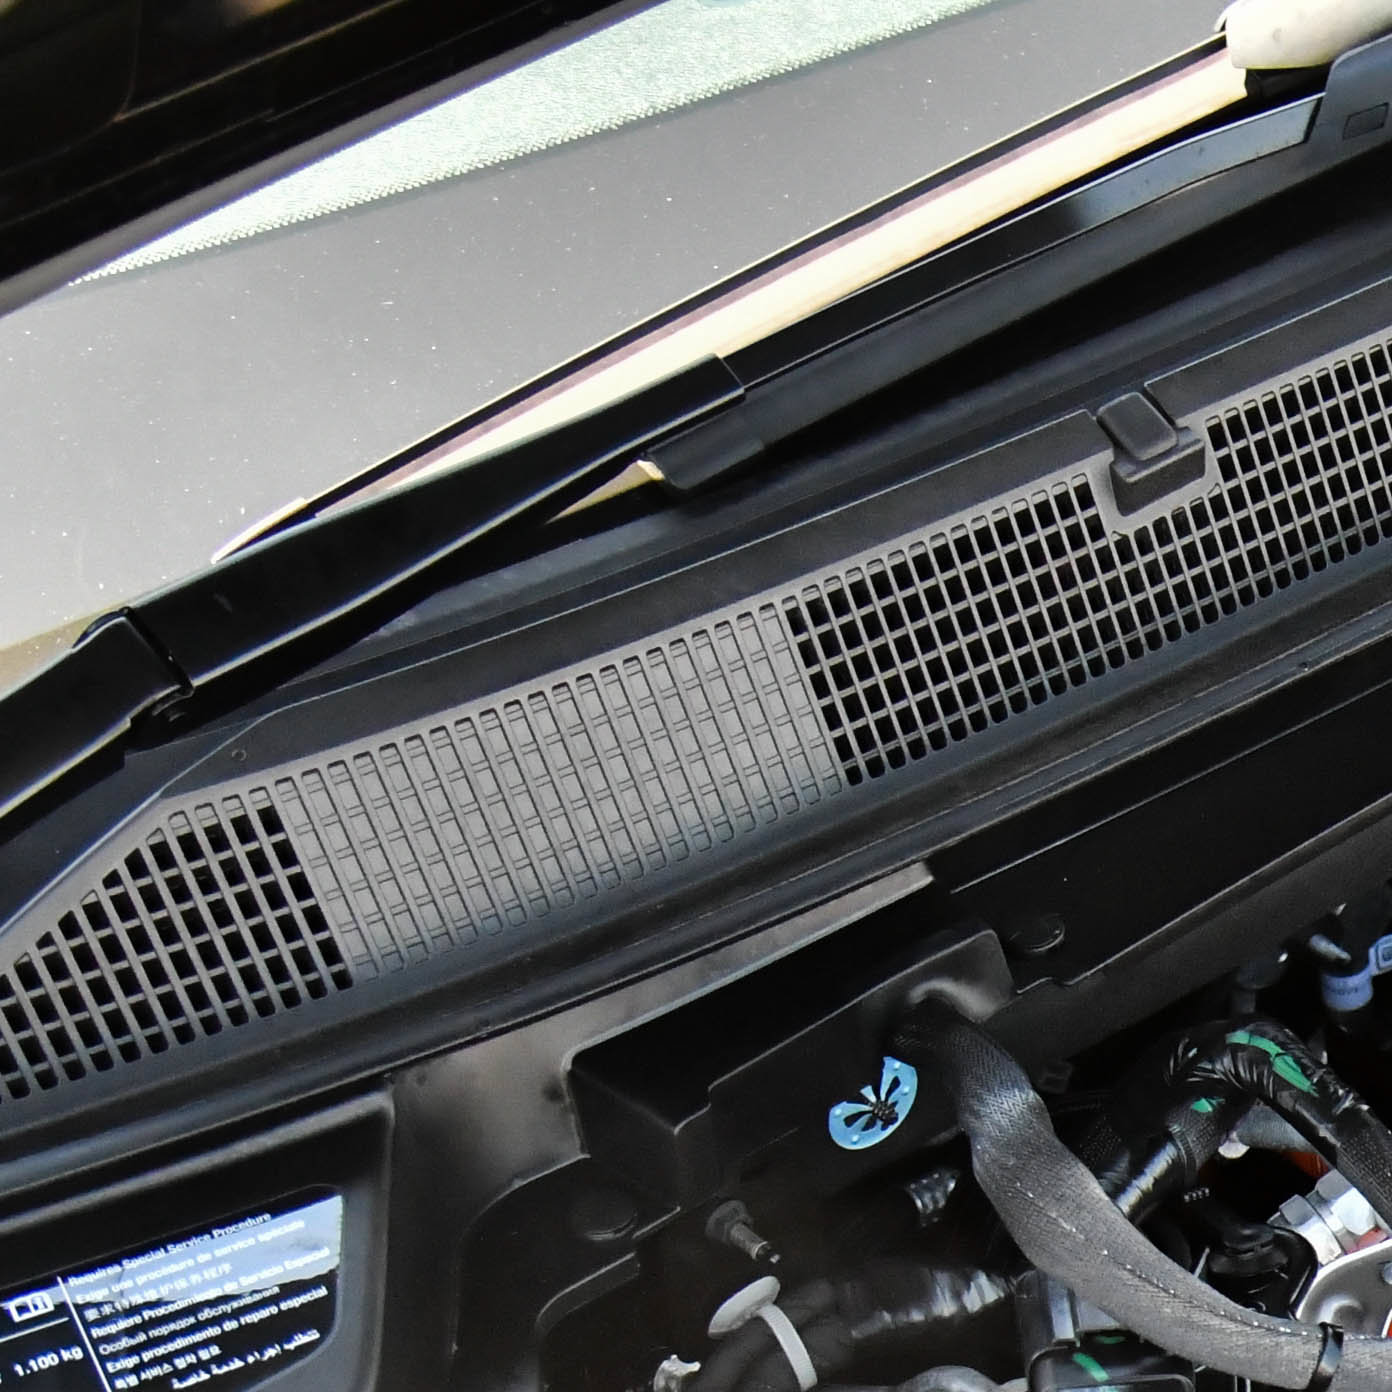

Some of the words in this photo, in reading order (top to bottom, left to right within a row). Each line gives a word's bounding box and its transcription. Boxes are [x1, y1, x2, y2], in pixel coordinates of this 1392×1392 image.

[67, 1261, 121, 1288] Requires
[121, 1247, 166, 1269] Special
[165, 1231, 212, 1253] Service
[211, 1211, 272, 1238] Procedure
[90, 1311, 142, 1339] Requiere
[97, 1329, 147, 1356] Особый
[148, 1314, 196, 1339] порядок
[141, 1322, 221, 1363] procedimento
[239, 1303, 278, 1325] reparo
[278, 1284, 328, 1311] especial
[13, 1352, 60, 1378] 1.100
[60, 1345, 84, 1361] kg
